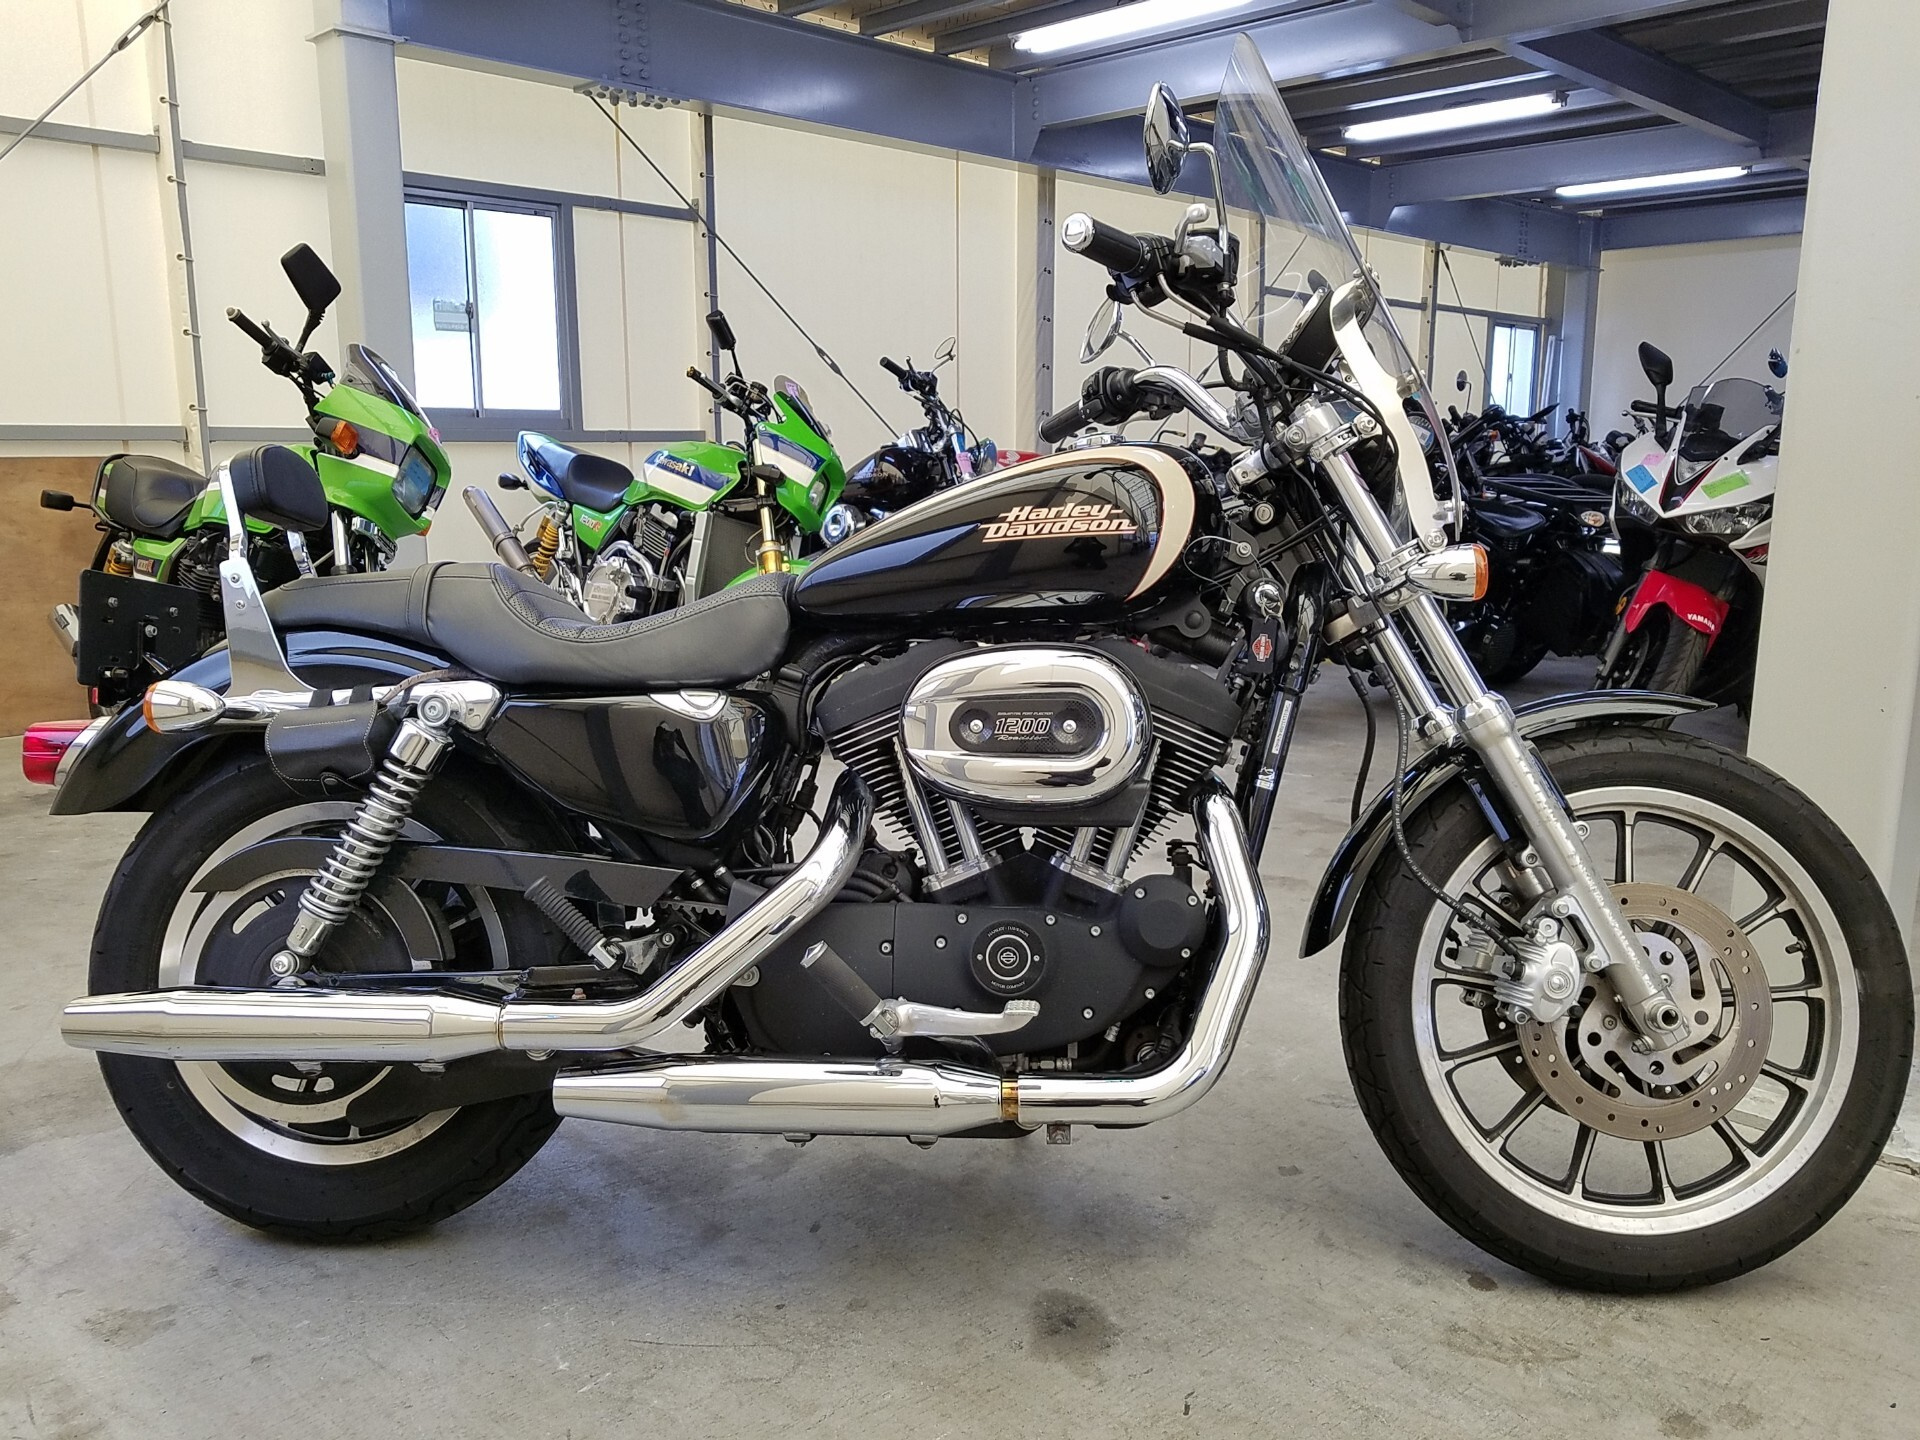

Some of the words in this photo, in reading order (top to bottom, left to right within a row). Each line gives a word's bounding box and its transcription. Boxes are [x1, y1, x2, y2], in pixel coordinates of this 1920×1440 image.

[978, 516, 1139, 538] Davidson
[1687, 613, 1715, 631] YAMAHA
[994, 717, 1051, 734] 1200
